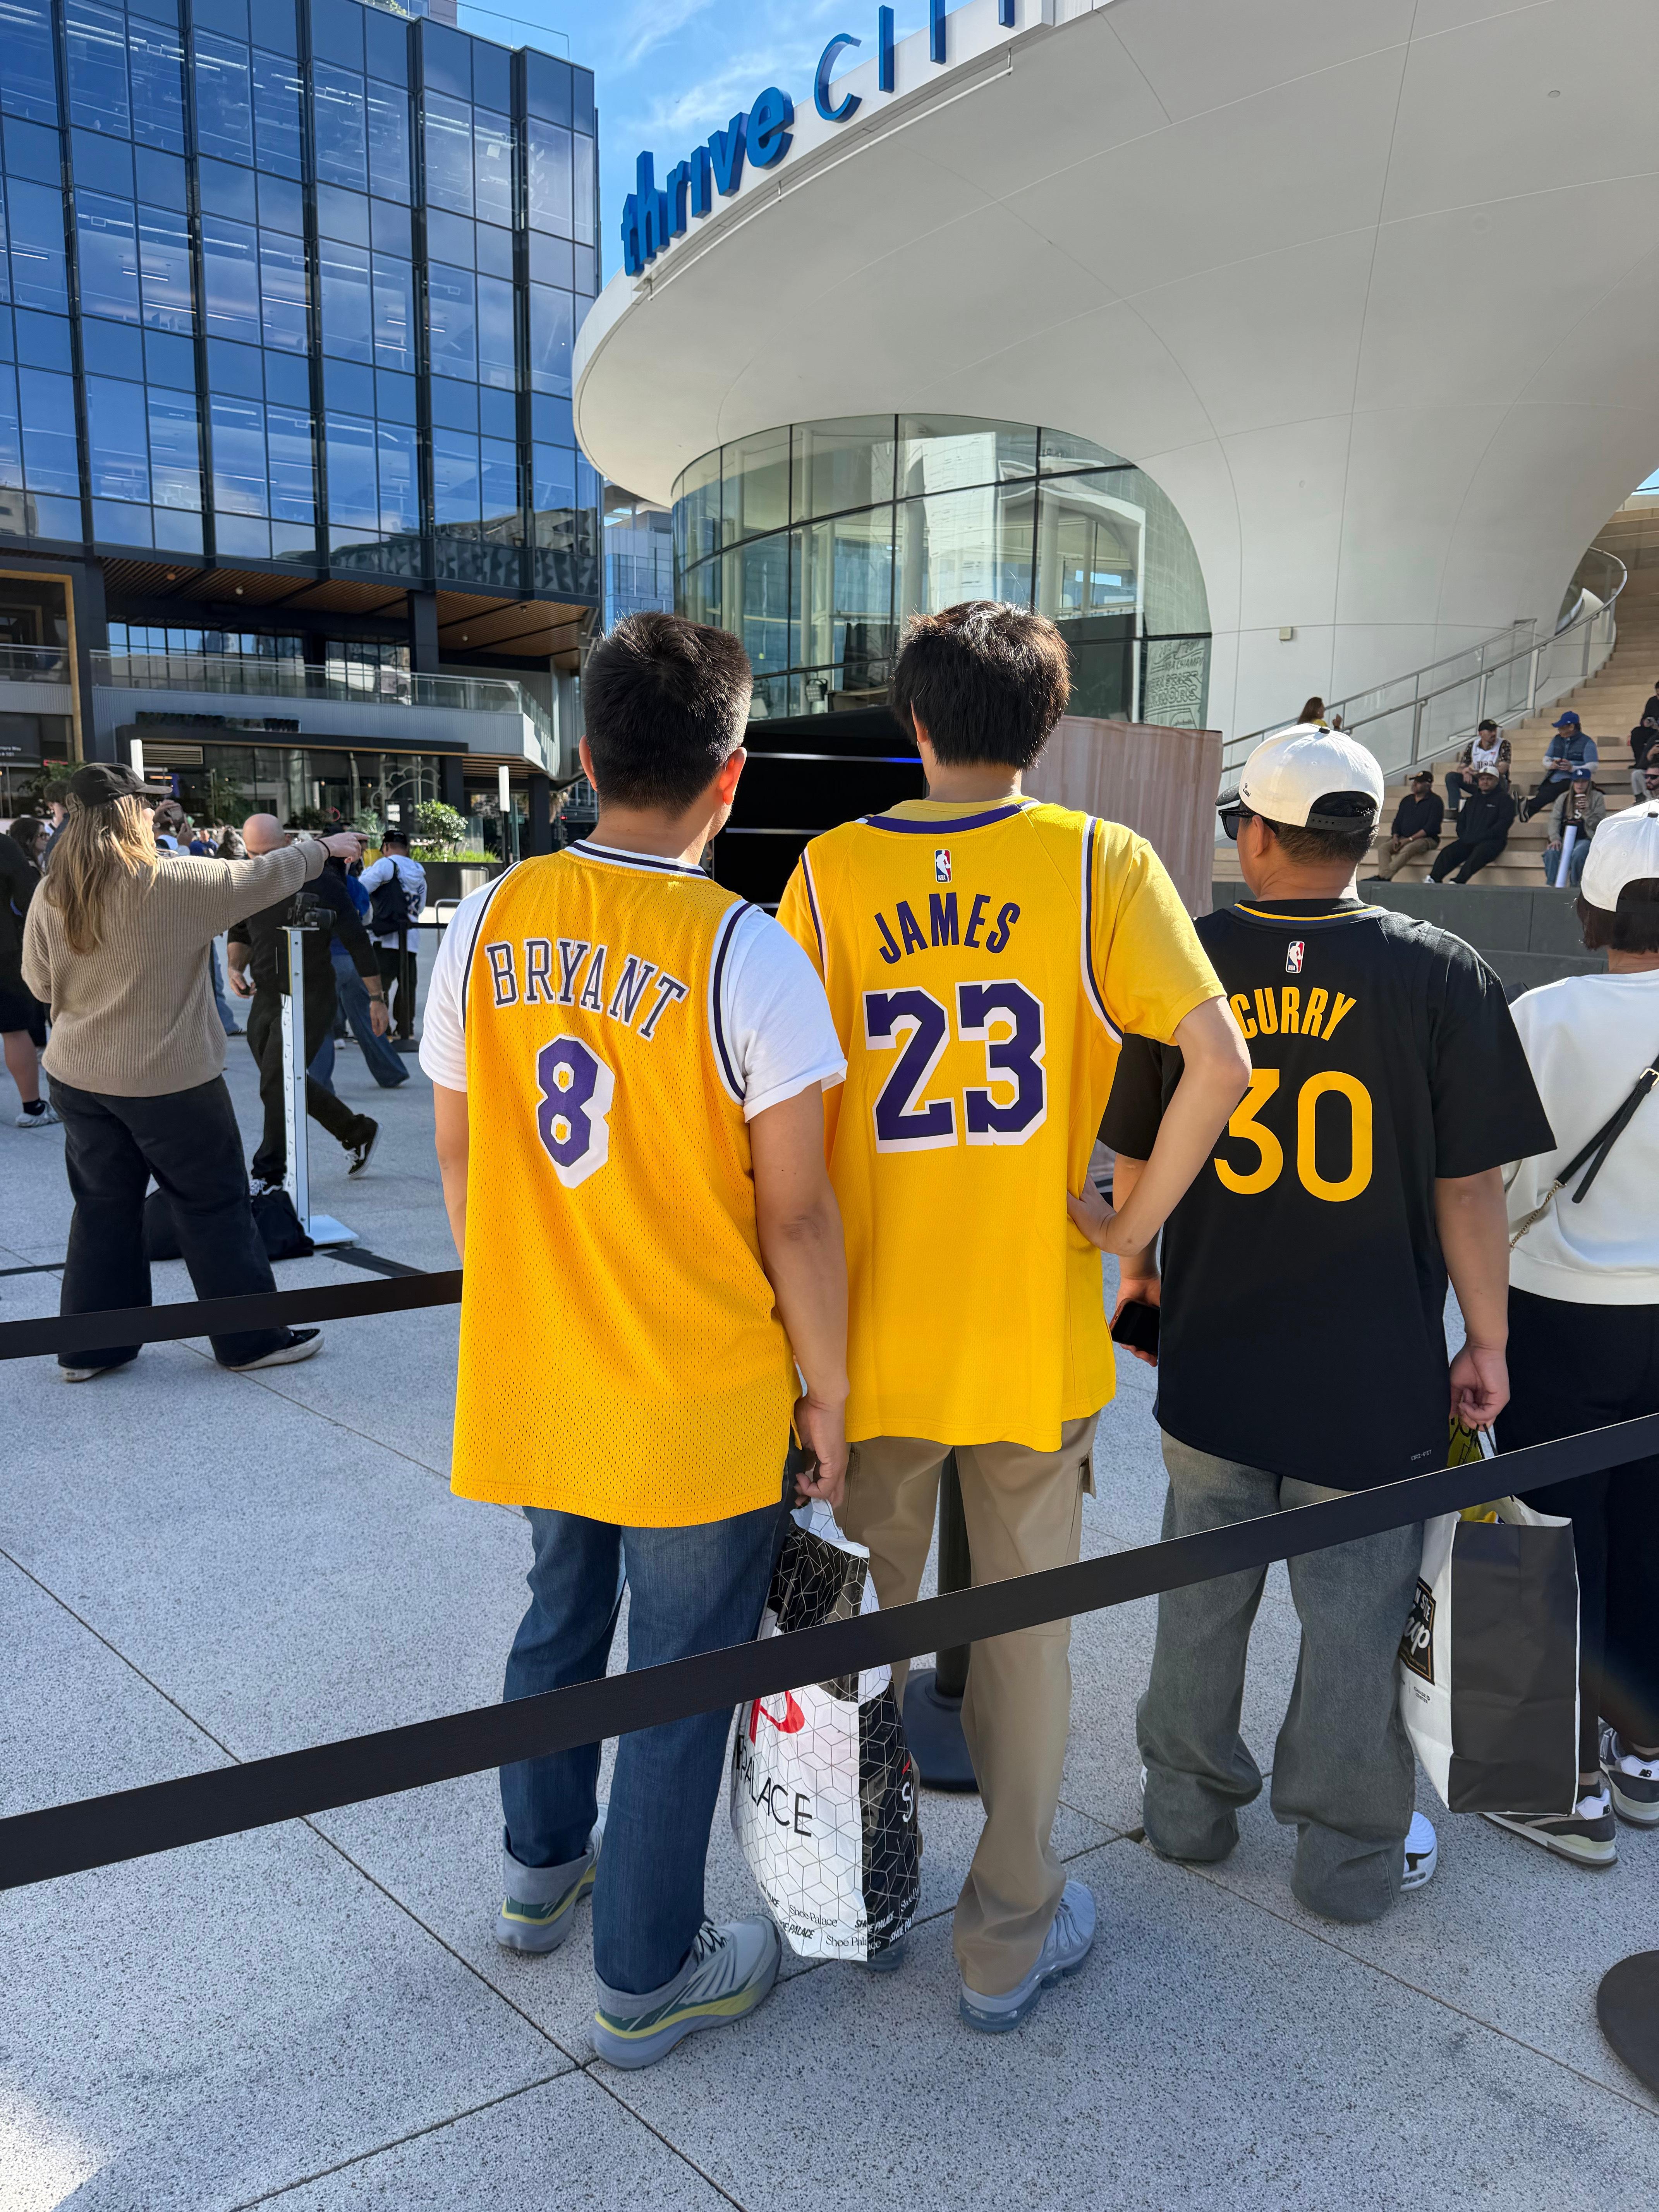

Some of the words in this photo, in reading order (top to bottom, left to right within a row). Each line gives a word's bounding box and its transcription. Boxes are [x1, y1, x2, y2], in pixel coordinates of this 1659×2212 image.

[620, 86, 794, 276] thrive
[814, 0, 1015, 123] CI
[874, 892, 1020, 964] JAMES
[484, 937, 690, 1042] BRYANT
[1230, 986, 1357, 1041] CURRY
[862, 978, 1048, 1153] 23
[536, 1034, 616, 1189] 8
[1214, 1068, 1372, 1202] 30
[1411, 1449, 1432, 1461] DRI-FIT
[740, 1745, 812, 1838] PALACE
[788, 1924, 815, 1939] PALACE
[789, 1905, 809, 1920] Shoe
[809, 1911, 838, 1927] Palace
[826, 1935, 849, 1947] Shoe
